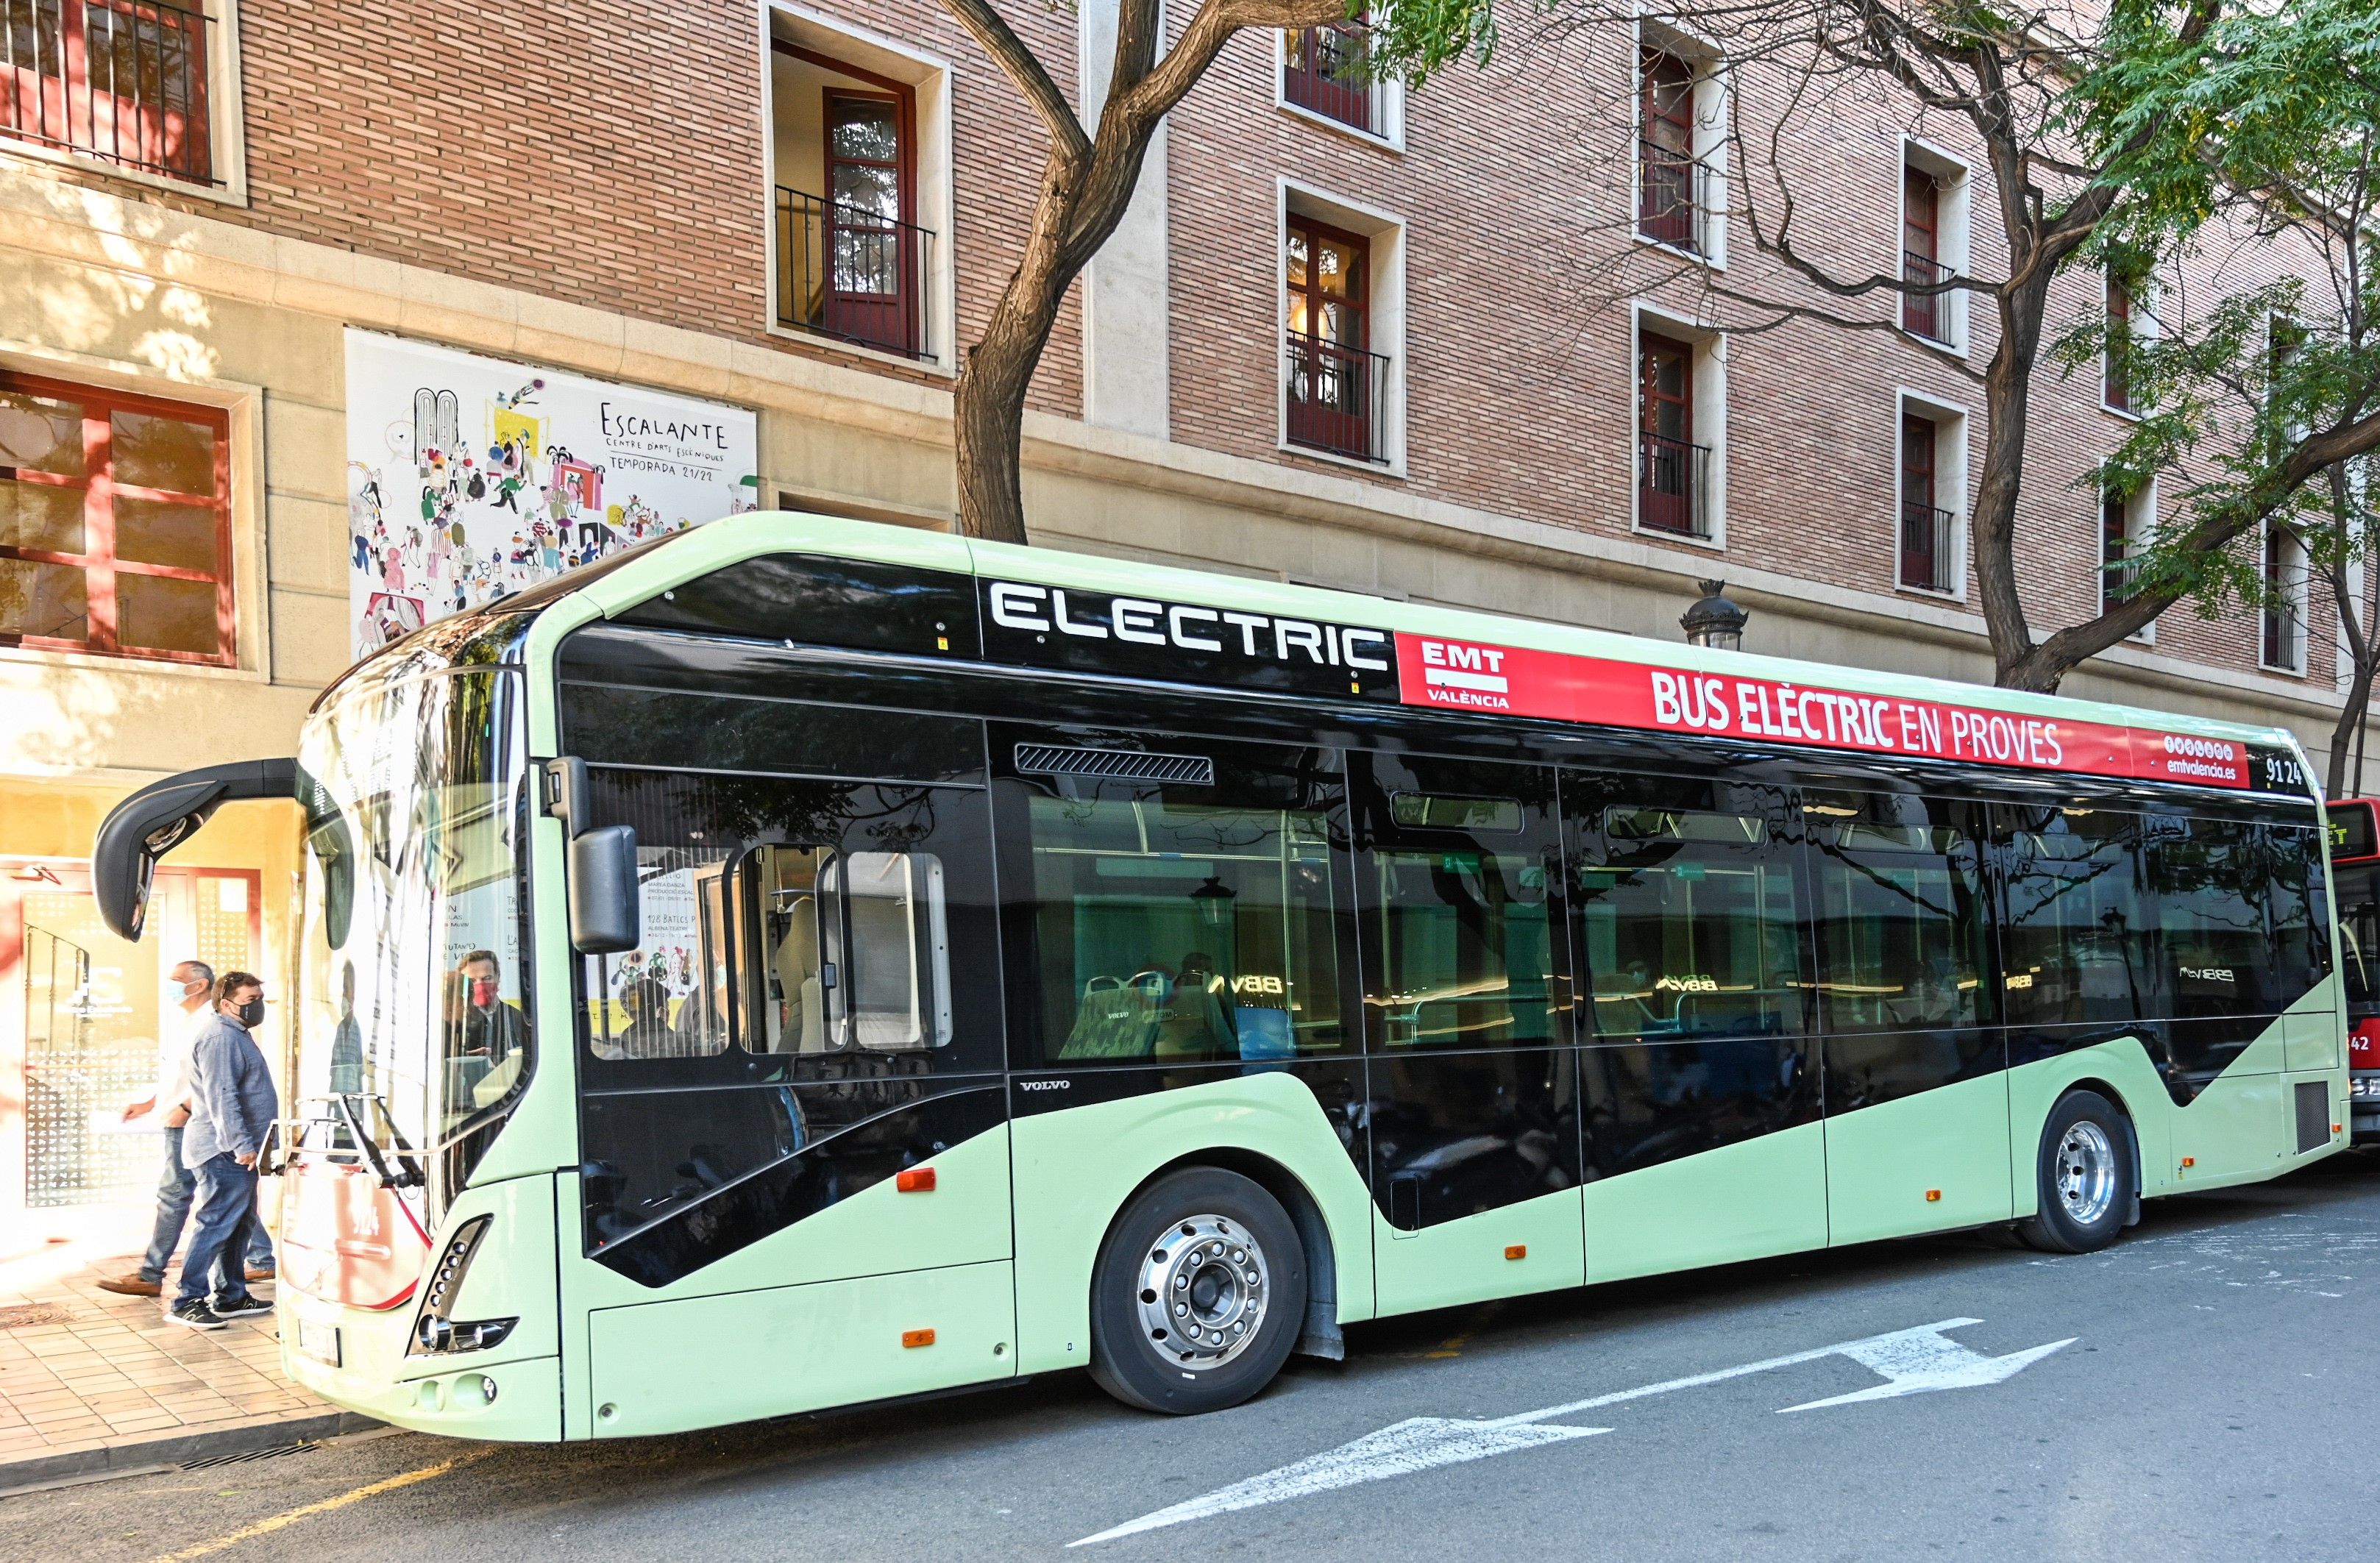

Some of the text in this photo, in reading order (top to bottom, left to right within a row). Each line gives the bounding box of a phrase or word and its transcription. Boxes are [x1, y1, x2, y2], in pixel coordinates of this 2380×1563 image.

[601, 402, 728, 449] ESCALANTE
[606, 438, 642, 449] CENTRE
[647, 442, 671, 453] D'ARTS
[609, 456, 712, 482] TEMPORADA 21/22
[991, 583, 1388, 672] ELECTRIC
[1421, 641, 1505, 672] EMT
[1427, 689, 1510, 709] VALÈNCIA
[1651, 671, 2062, 766] BUS ELÈCTRIC EN PROVES
[2167, 758, 2236, 780] emtvalencia.es
[1107, 1011, 1129, 1019] VOLVO
[1020, 1080, 1070, 1092] VOLVO
